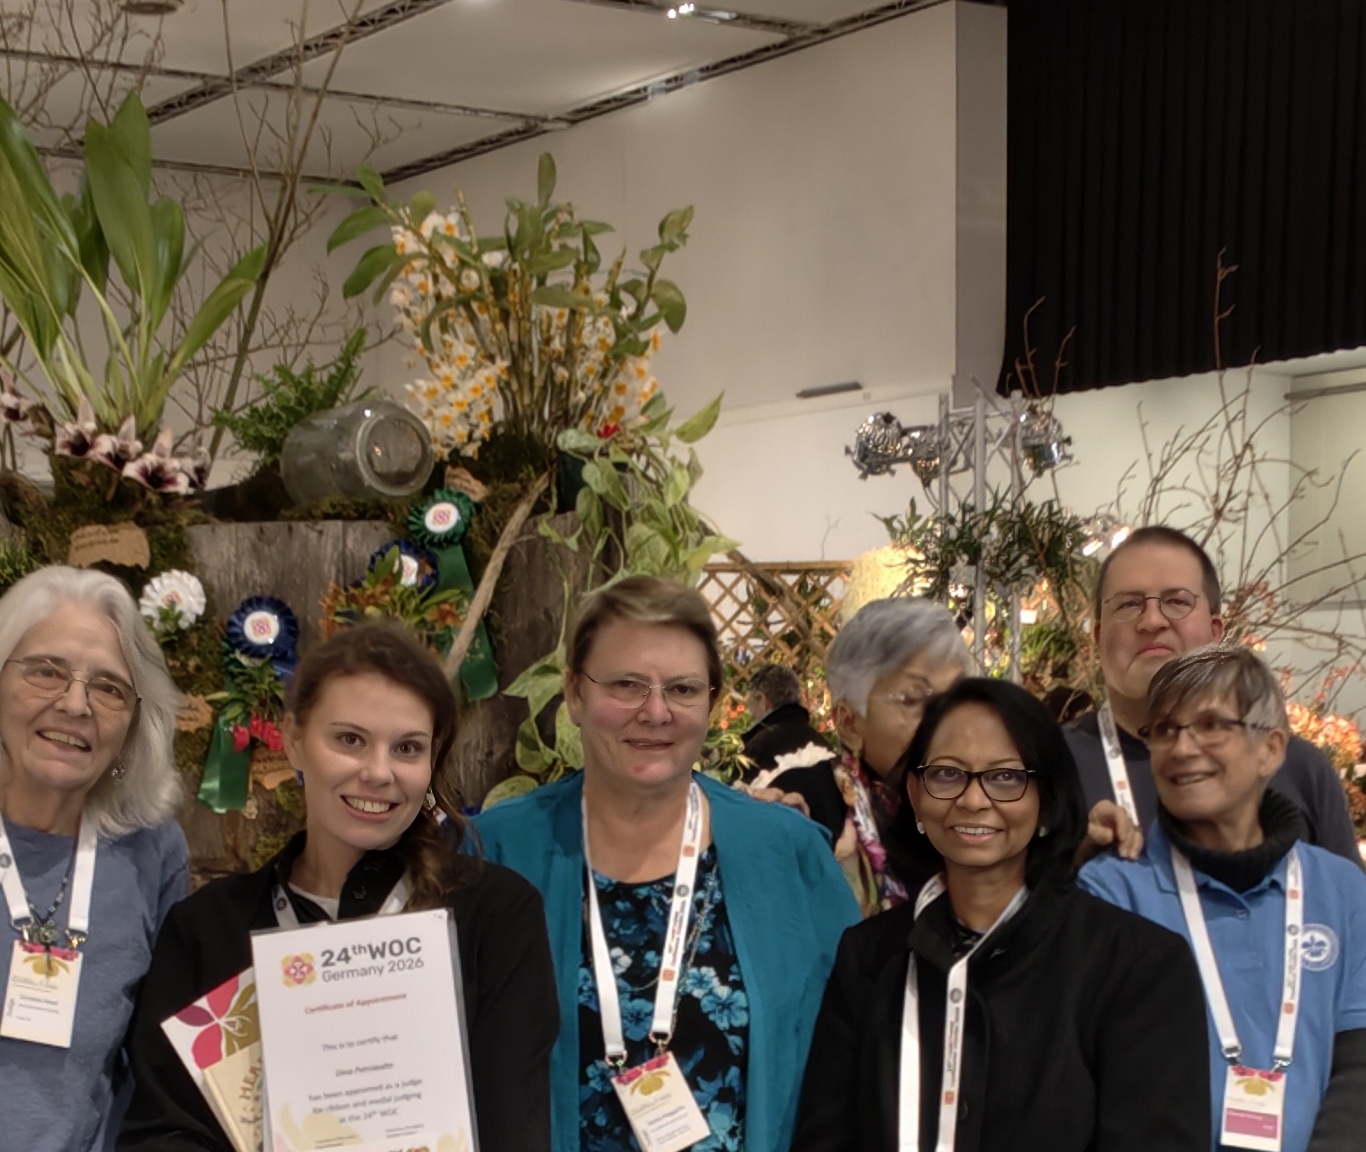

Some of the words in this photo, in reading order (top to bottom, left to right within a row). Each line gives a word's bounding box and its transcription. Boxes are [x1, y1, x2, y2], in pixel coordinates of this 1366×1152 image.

[321, 964, 385, 982] Germany
[387, 957, 425, 973] 2026
[304, 1001, 344, 1014] Certificate
